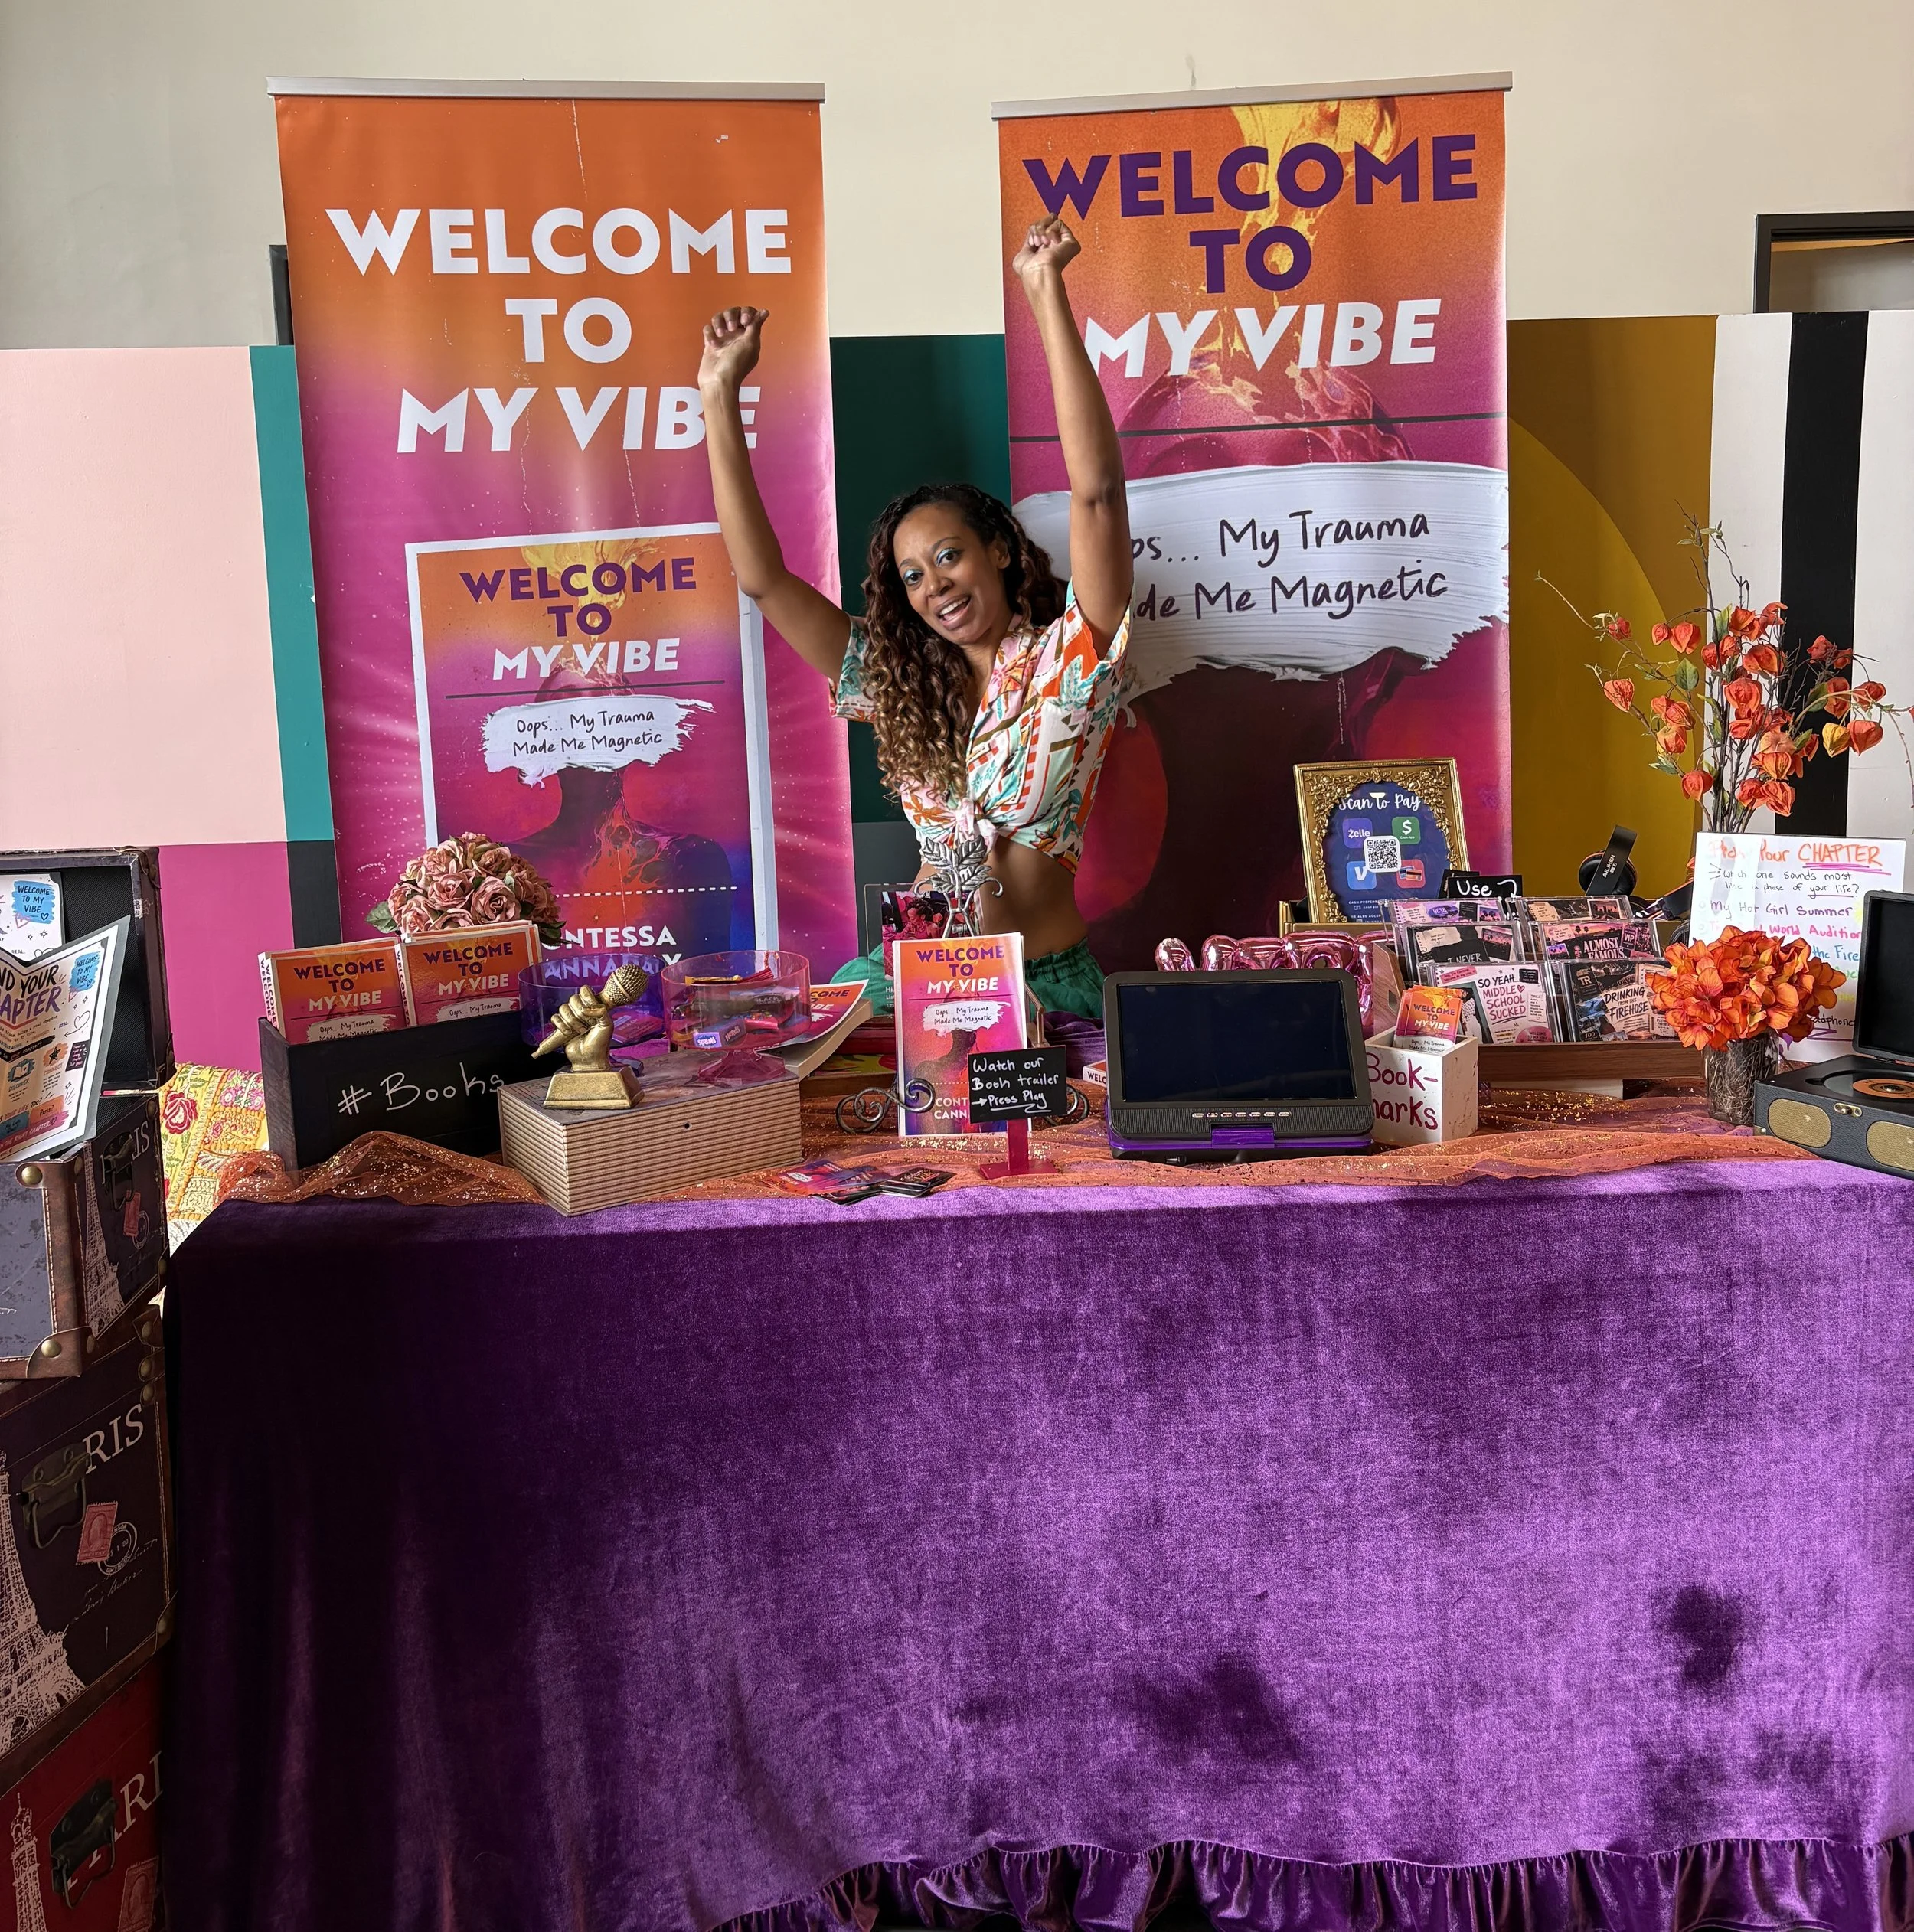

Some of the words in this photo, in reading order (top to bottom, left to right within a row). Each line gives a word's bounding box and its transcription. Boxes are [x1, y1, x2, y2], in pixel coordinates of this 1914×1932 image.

[1021, 134, 1478, 220] WELCOME
[325, 207, 792, 276] WELCOME
[1190, 226, 1312, 294] TO
[505, 298, 632, 364] TO
[1083, 309, 1219, 378] MY
[1236, 299, 1442, 371] VIBE
[397, 387, 539, 453] MY
[1220, 518, 1279, 567] My
[1289, 510, 1429, 551] Trauma
[459, 557, 697, 603] WELCOME
[1132, 583, 1181, 621] de
[1194, 581, 1256, 619] Me
[1271, 559, 1449, 619] Magnetic
[547, 603, 612, 637] TO
[492, 646, 564, 680] MY
[572, 638, 681, 675] VIBE
[570, 713, 595, 733] My
[602, 710, 655, 727] Trauma
[513, 739, 557, 757] Made
[561, 737, 586, 754] Me
[591, 732, 663, 753] Magnetic
[1338, 798, 1373, 811] Scan
[1394, 793, 1421, 811] Pay
[1347, 829, 1370, 839] Zelle
[1798, 843, 1883, 866] CHAPTER
[1824, 872, 1851, 880] most
[18, 885, 50, 895] WELCOME
[1456, 880, 1492, 897] Use
[1764, 883, 1784, 893] phase
[1793, 883, 1803, 891] of
[1809, 885, 1828, 899] your
[1835, 883, 1860, 897] life?
[24, 905, 41, 913] VIBE
[1765, 903, 1789, 915] Girl
[1796, 906, 1853, 916] Summer
[543, 925, 677, 950] NTESSA
[1624, 933, 1635, 942] VIP
[423, 942, 513, 964] WELCOME
[916, 945, 1004, 963] WELCOME
[1457, 953, 1482, 963] NEVER
[1812, 945, 1830, 958] the
[77, 955, 98, 968] WELCOME
[293, 958, 386, 980] WELCOME
[458, 962, 483, 977] TO
[949, 964, 973, 977] TO
[21, 964, 59, 998] YOUR
[328, 978, 354, 993] TO
[396, 951, 408, 1010] WELCOME
[439, 979, 465, 996] MY
[467, 973, 509, 992] VIBE
[927, 980, 955, 994] MY
[958, 977, 999, 993] VIBE
[1478, 978, 1490, 988] SO
[1492, 974, 1514, 986] YEAH
[1482, 985, 1517, 999] MIDDLE
[1604, 987, 1645, 1004] DRINKING
[0, 986, 61, 1024] APTER
[309, 995, 336, 1012] MY
[340, 990, 381, 1007] VIBE
[1486, 995, 1526, 1010] SCHOOL
[469, 1006, 480, 1014] My
[1413, 1004, 1455, 1016] WELCOME
[1489, 1005, 1527, 1021] SUCKED
[1609, 1001, 1649, 1022] FIREHOSE
[351, 1020, 374, 1028] Trauma
[1429, 1021, 1450, 1030] VIBE
[972, 1058, 1015, 1072] Watch
[1024, 1057, 1044, 1069] our
[1017, 1074, 1059, 1086] trailer
[1087, 1071, 1107, 1083] WELC
[935, 1097, 968, 1108] CONT
[988, 1094, 1018, 1107] Press
[1023, 1090, 1047, 1109] Play
[934, 1110, 969, 1120] CANN
